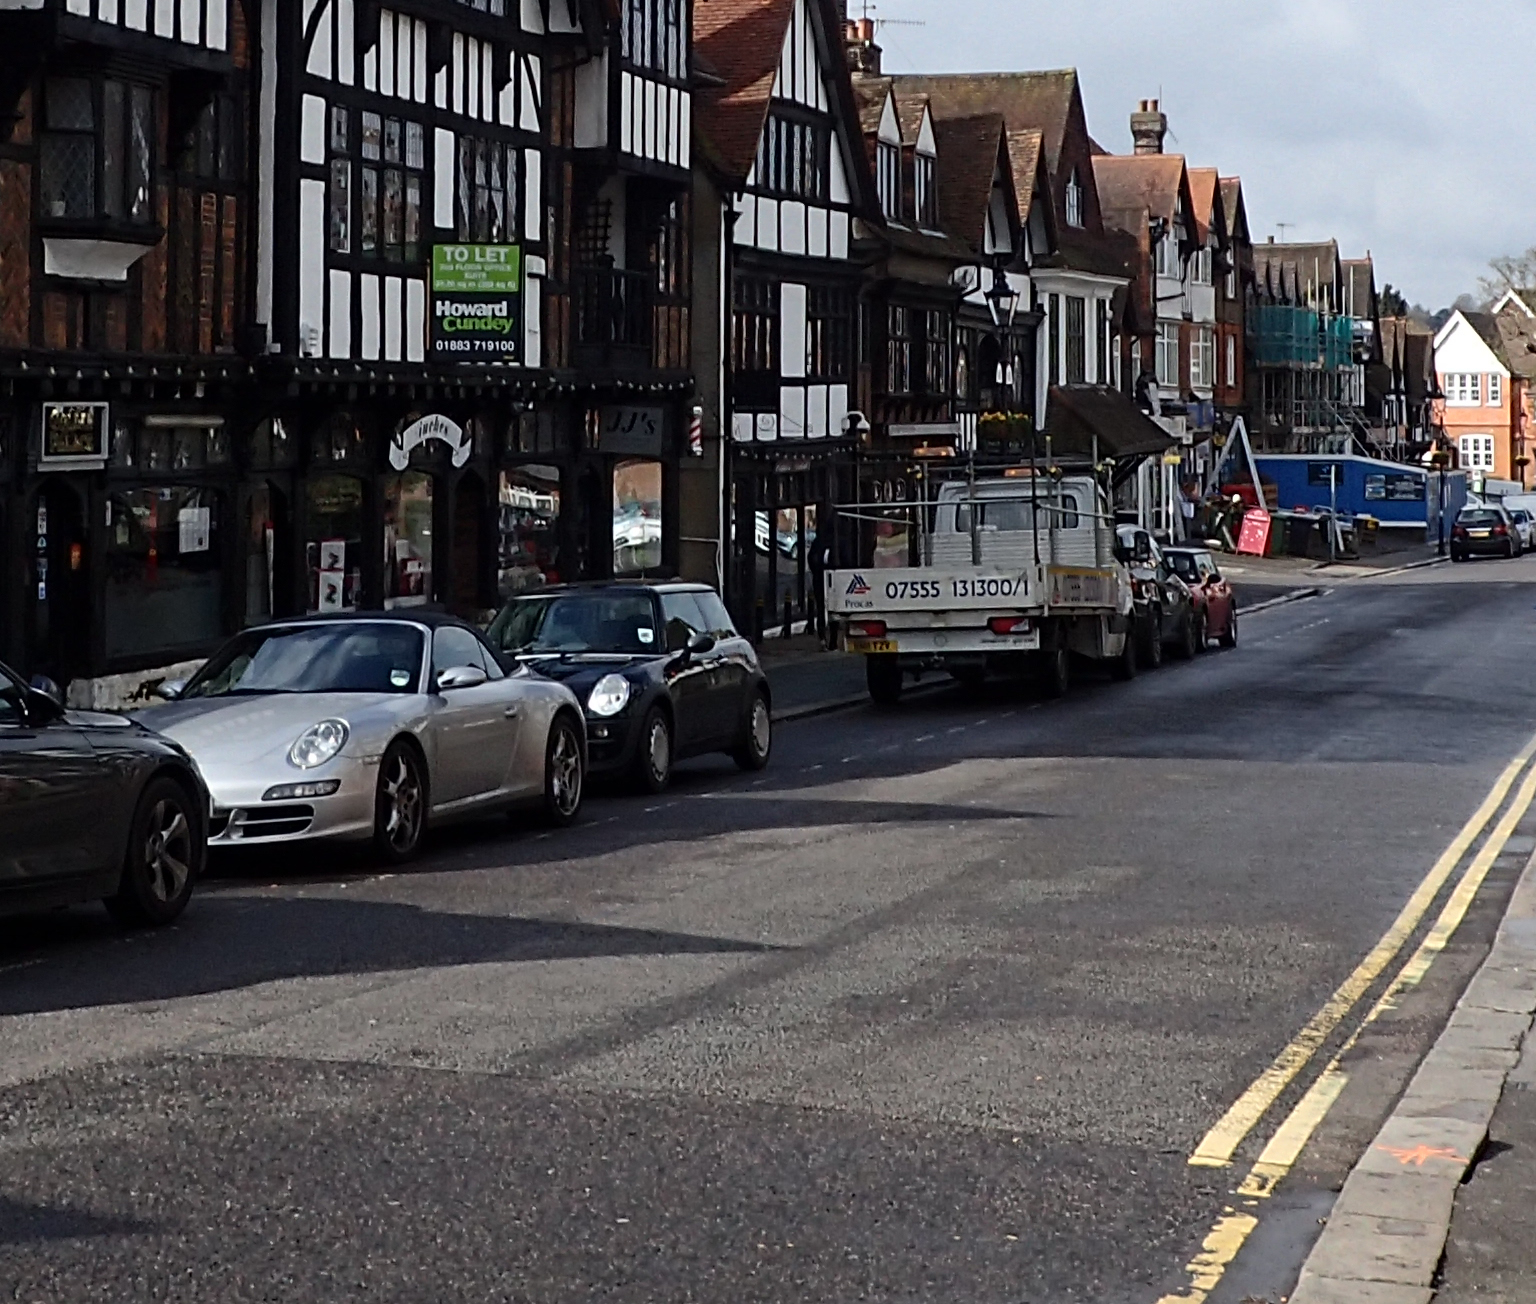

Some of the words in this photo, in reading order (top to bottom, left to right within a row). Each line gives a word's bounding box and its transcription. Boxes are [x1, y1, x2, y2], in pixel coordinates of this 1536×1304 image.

[442, 246, 469, 263] TO
[474, 246, 510, 263] LET
[435, 300, 508, 317] Howard
[442, 316, 514, 334] Cundey
[435, 339, 471, 351] 01883
[473, 340, 515, 352] 719100
[606, 410, 657, 435] JJ's
[885, 579, 940, 599] 07555
[952, 578, 1029, 598] 131300/1
